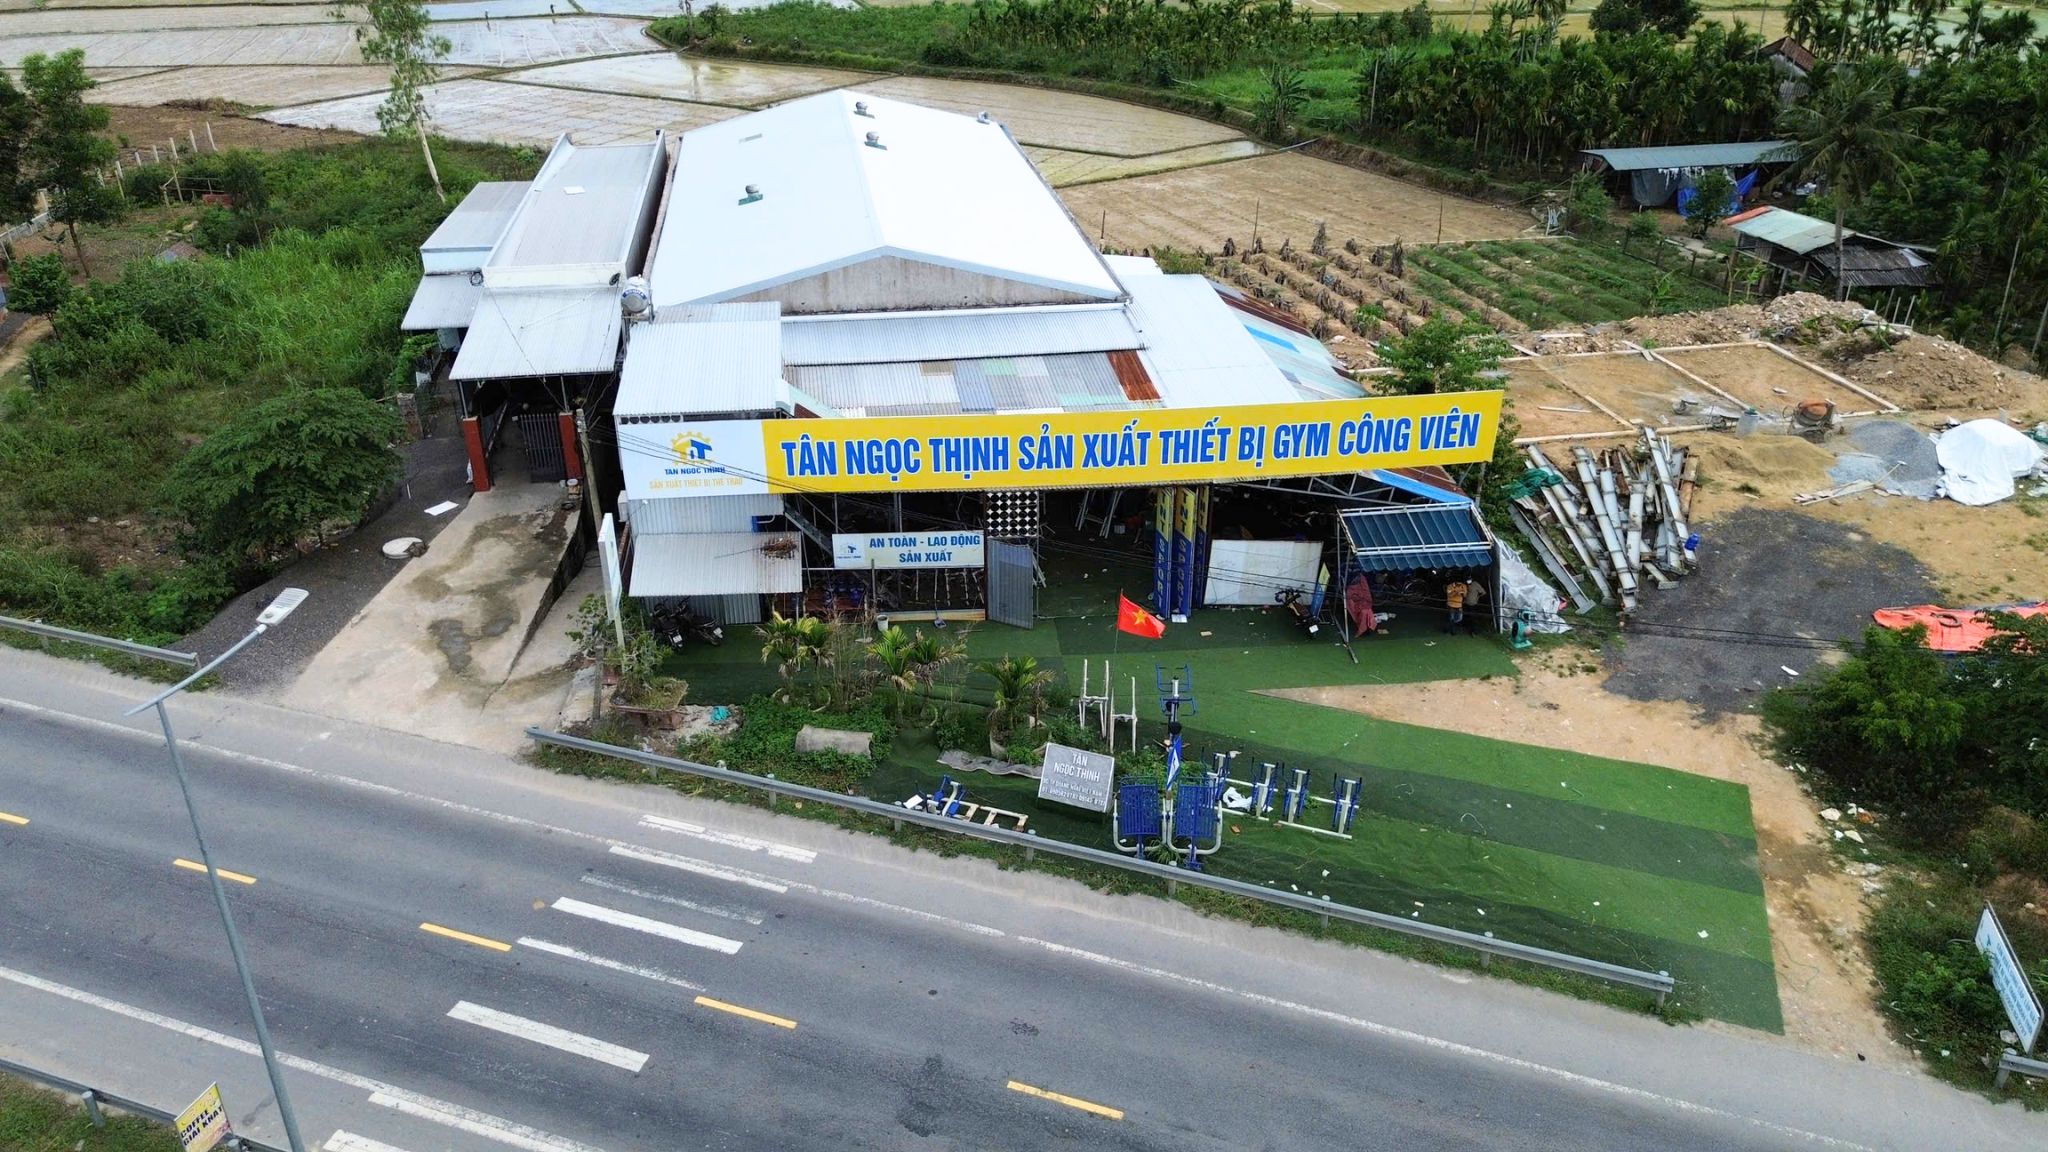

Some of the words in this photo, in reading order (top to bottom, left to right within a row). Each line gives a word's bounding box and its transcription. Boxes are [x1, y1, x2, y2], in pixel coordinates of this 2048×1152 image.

[780, 433, 836, 476] TÂN
[845, 437, 921, 482] NGỌC
[928, 436, 1009, 480] THỊNH
[1018, 423, 1073, 470] SẢN
[1082, 419, 1151, 469] XUẤT
[1159, 416, 1232, 464] THIẾT
[1238, 425, 1266, 468] BỊ
[1273, 422, 1331, 459] GYM
[1338, 412, 1411, 454] CÔNG
[1420, 407, 1480, 450] VIÊN
[869, 537, 885, 548] AN
[888, 534, 917, 547] TOÀN
[927, 536, 948, 547] LAO
[950, 533, 980, 548] ĐỘNG
[899, 550, 921, 563] SẢN
[925, 548, 953, 562] XUẤT
[1072, 752, 1088, 767] TÂN
[1053, 762, 1075, 776] NGỌC
[1077, 767, 1100, 782] THỊNH
